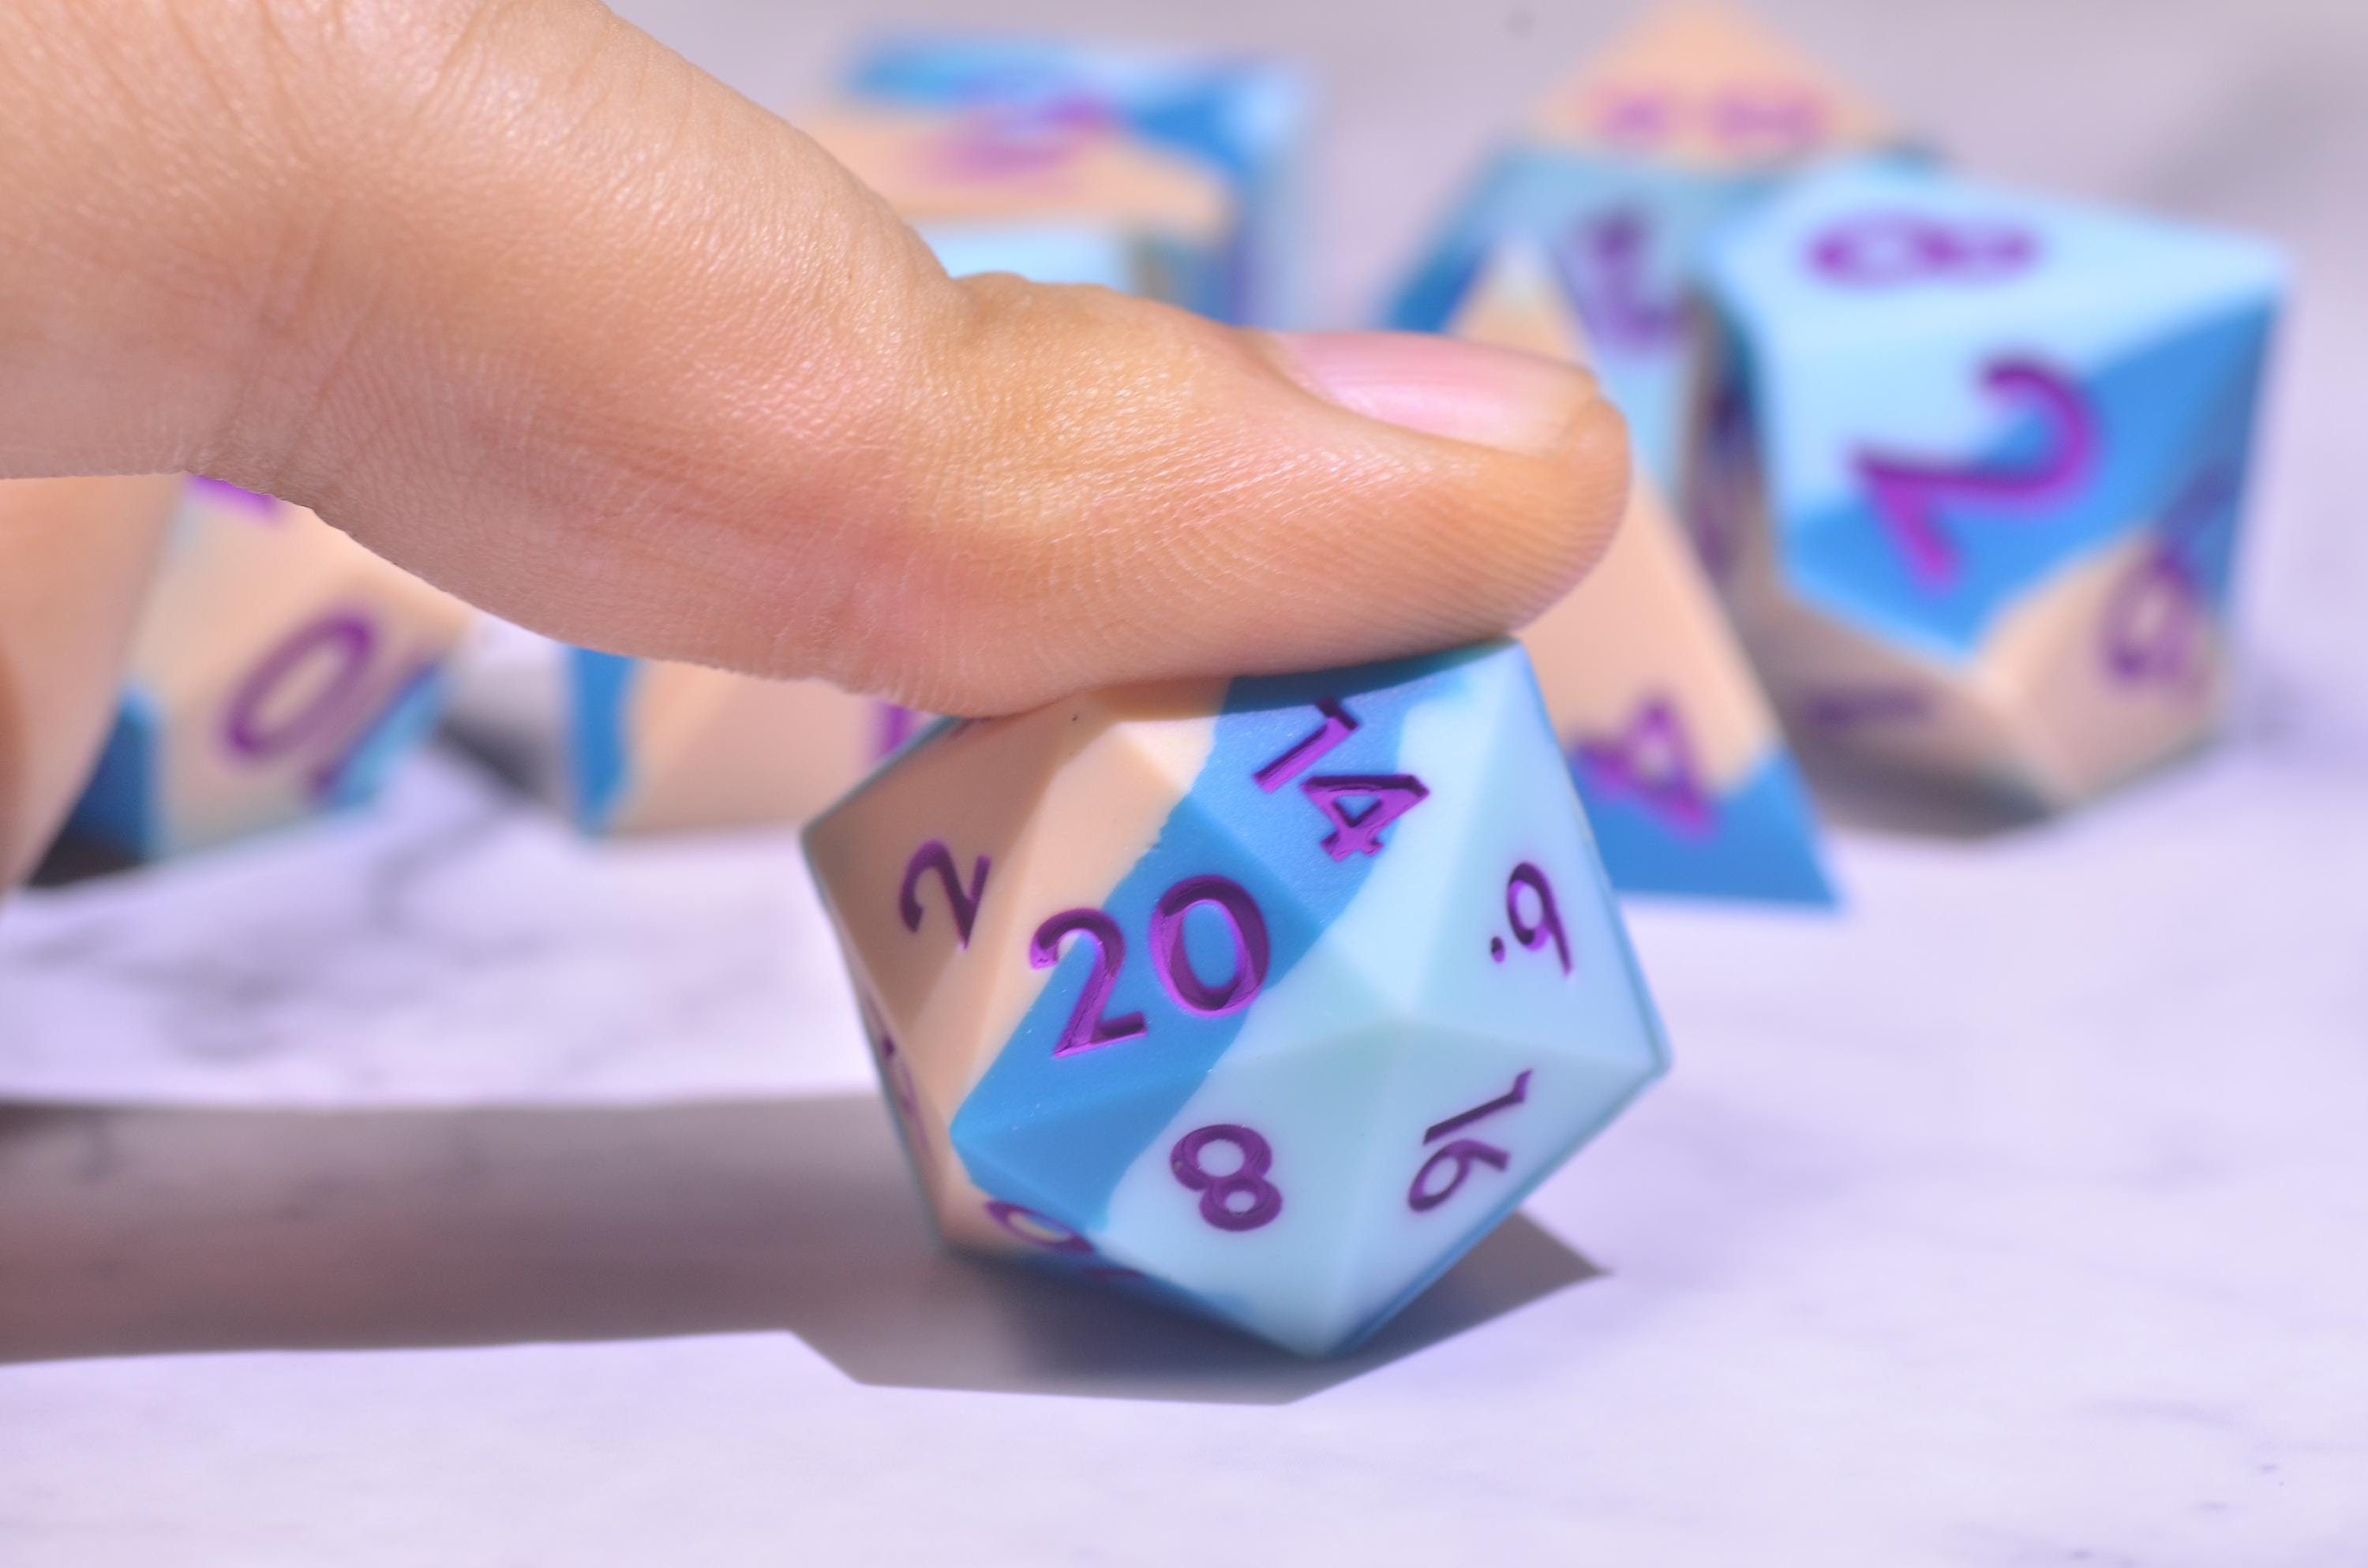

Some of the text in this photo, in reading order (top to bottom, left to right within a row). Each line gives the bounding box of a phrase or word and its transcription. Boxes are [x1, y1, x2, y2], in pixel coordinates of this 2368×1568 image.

[1843, 349, 2101, 593] 2
[1252, 695, 1430, 862] 14
[898, 840, 992, 949] 2
[1029, 874, 1271, 1058] 20
[1170, 1123, 1283, 1232] 8
[1408, 1068, 1534, 1213] 16
